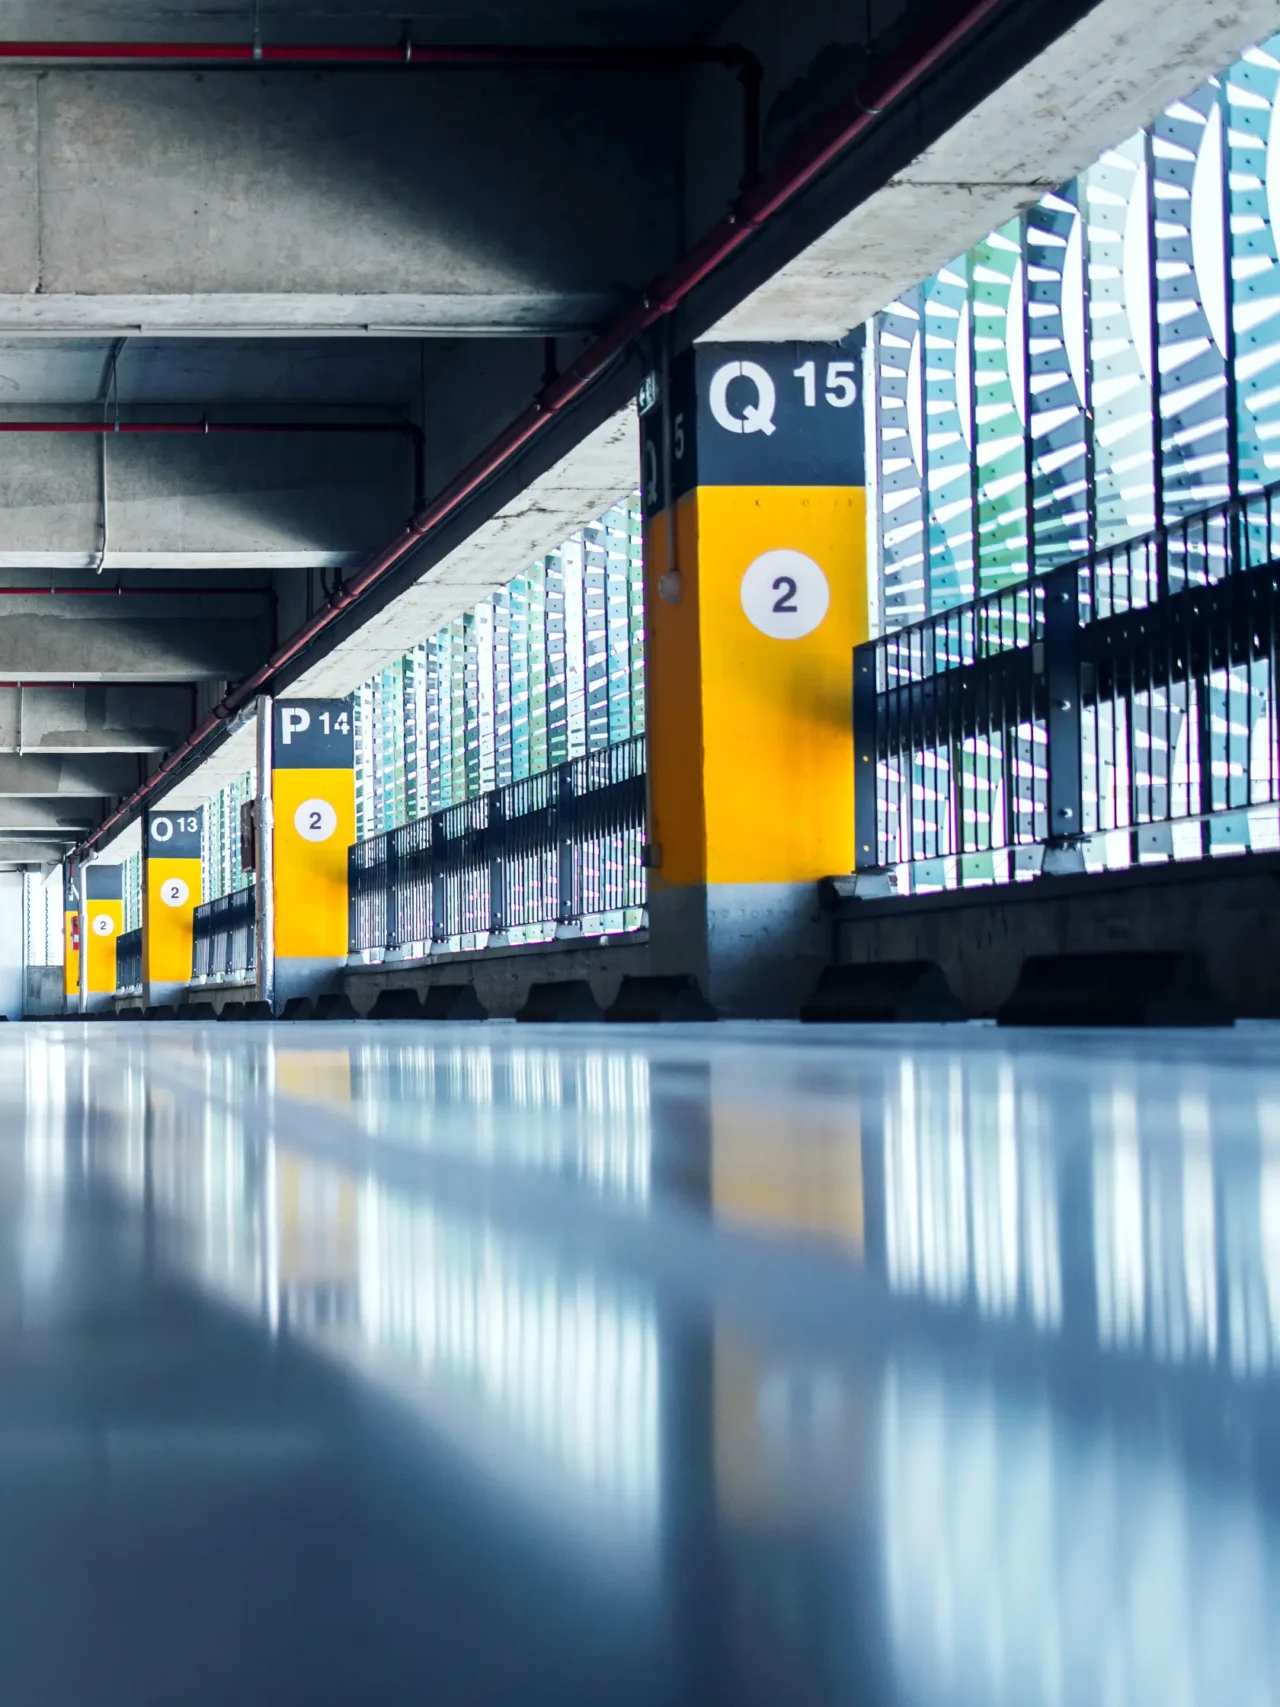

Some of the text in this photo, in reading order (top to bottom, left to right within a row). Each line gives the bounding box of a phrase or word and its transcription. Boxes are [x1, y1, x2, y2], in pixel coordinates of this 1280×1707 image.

[709, 360, 857, 436] Q 15
[772, 576, 798, 613] 2
[281, 707, 350, 745] P 14
[151, 817, 198, 842] O 13
[309, 812, 322, 830] 2
[170, 886, 180, 899] 2
[100, 921, 107, 930] 2
